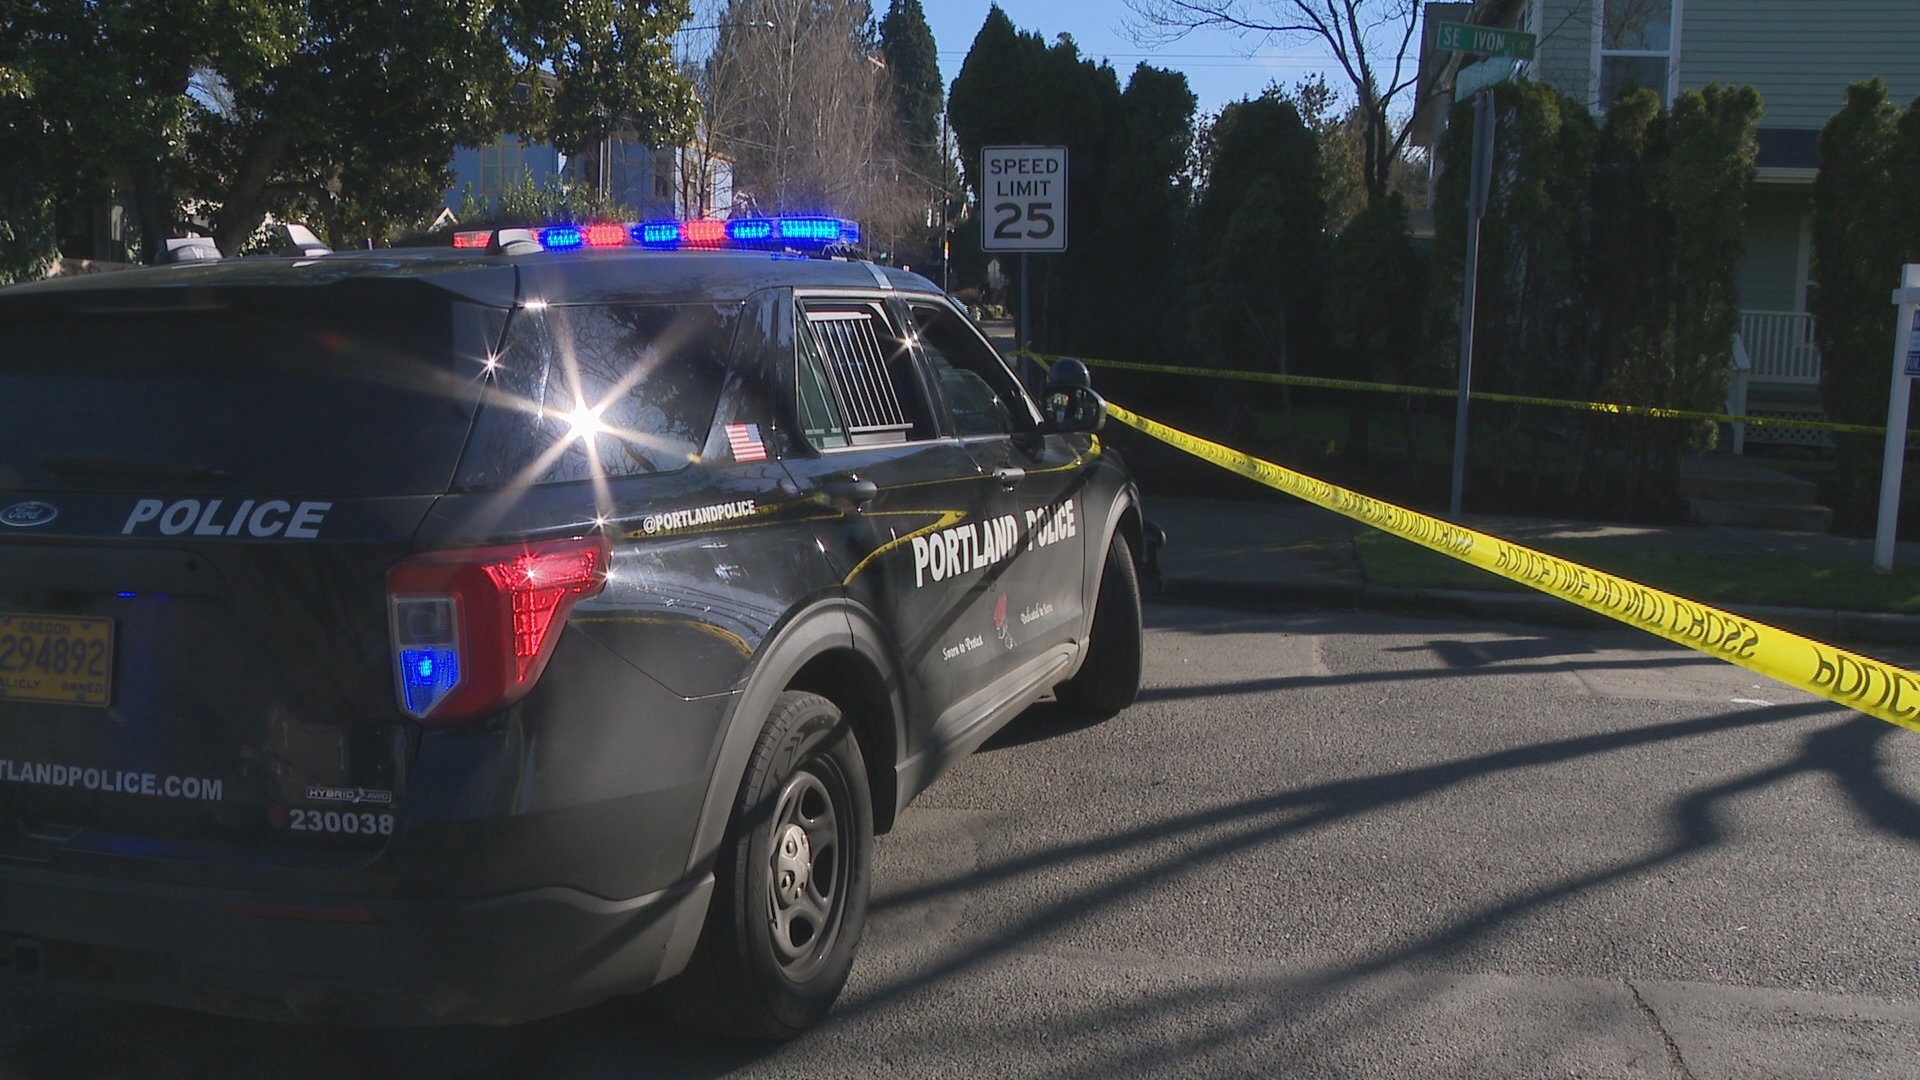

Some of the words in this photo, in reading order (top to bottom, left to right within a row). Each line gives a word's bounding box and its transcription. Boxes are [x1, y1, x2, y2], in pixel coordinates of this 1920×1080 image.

[1443, 26, 1462, 47] SE
[1472, 31, 1506, 52] IVON
[990, 158, 1059, 175] SPEED
[997, 180, 1051, 197] LIMIT
[993, 202, 1055, 240] 25
[8, 505, 44, 520] Ford
[120, 498, 333, 539] POLICE
[643, 499, 756, 534] @PORTLANDPOLICE
[911, 513, 1018, 589] PORTLAND
[1025, 498, 1077, 553] POLICE
[20, 621, 71, 635] OREGON
[0, 634, 105, 677] 294892
[941, 643, 960, 661] Sworn
[965, 634, 984, 652] Protect
[61, 681, 103, 694] OWNED
[309, 788, 355, 798] HYBRID
[366, 792, 389, 800] AWD
[289, 808, 394, 836] 230038
